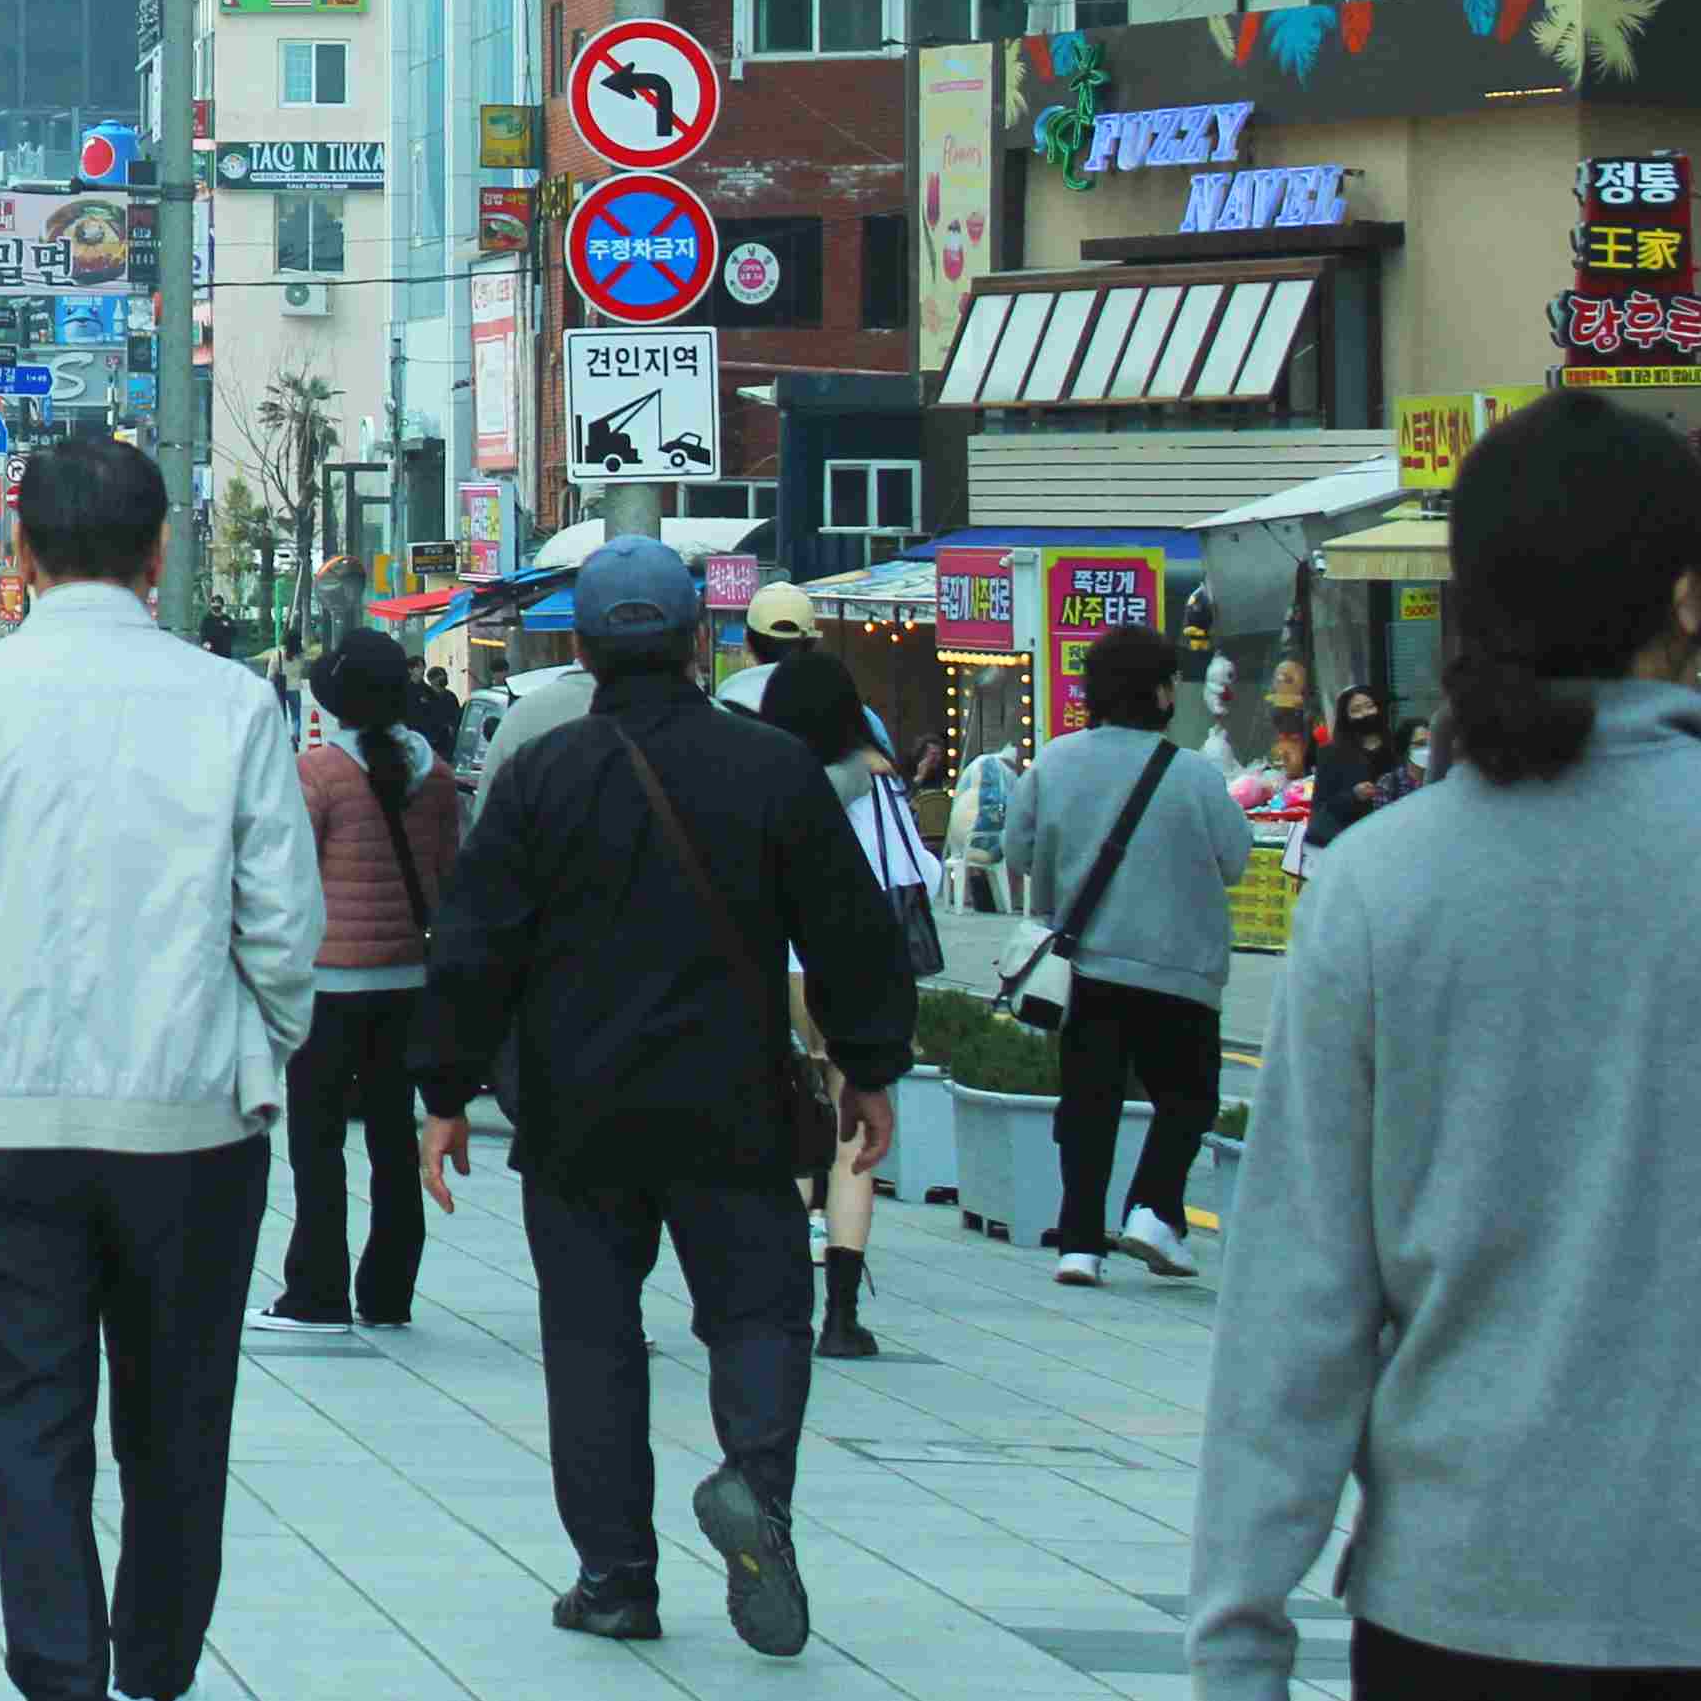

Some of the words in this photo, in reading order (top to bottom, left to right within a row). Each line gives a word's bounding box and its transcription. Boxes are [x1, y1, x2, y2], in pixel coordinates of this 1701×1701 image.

[1083, 101, 1255, 172] FUZZY
[248, 143, 296, 172] TACO
[303, 143, 318, 170] N
[326, 143, 384, 171] TIKKA
[1179, 164, 1348, 233] NAVEL
[1594, 162, 1680, 205] 정통
[588, 236, 696, 261] 주정차금지
[1588, 226, 1683, 270] 王家
[586, 345, 698, 378] 견인지역
[1072, 568, 1136, 595] 쪽집게
[1060, 595, 1148, 626] 사주타로
